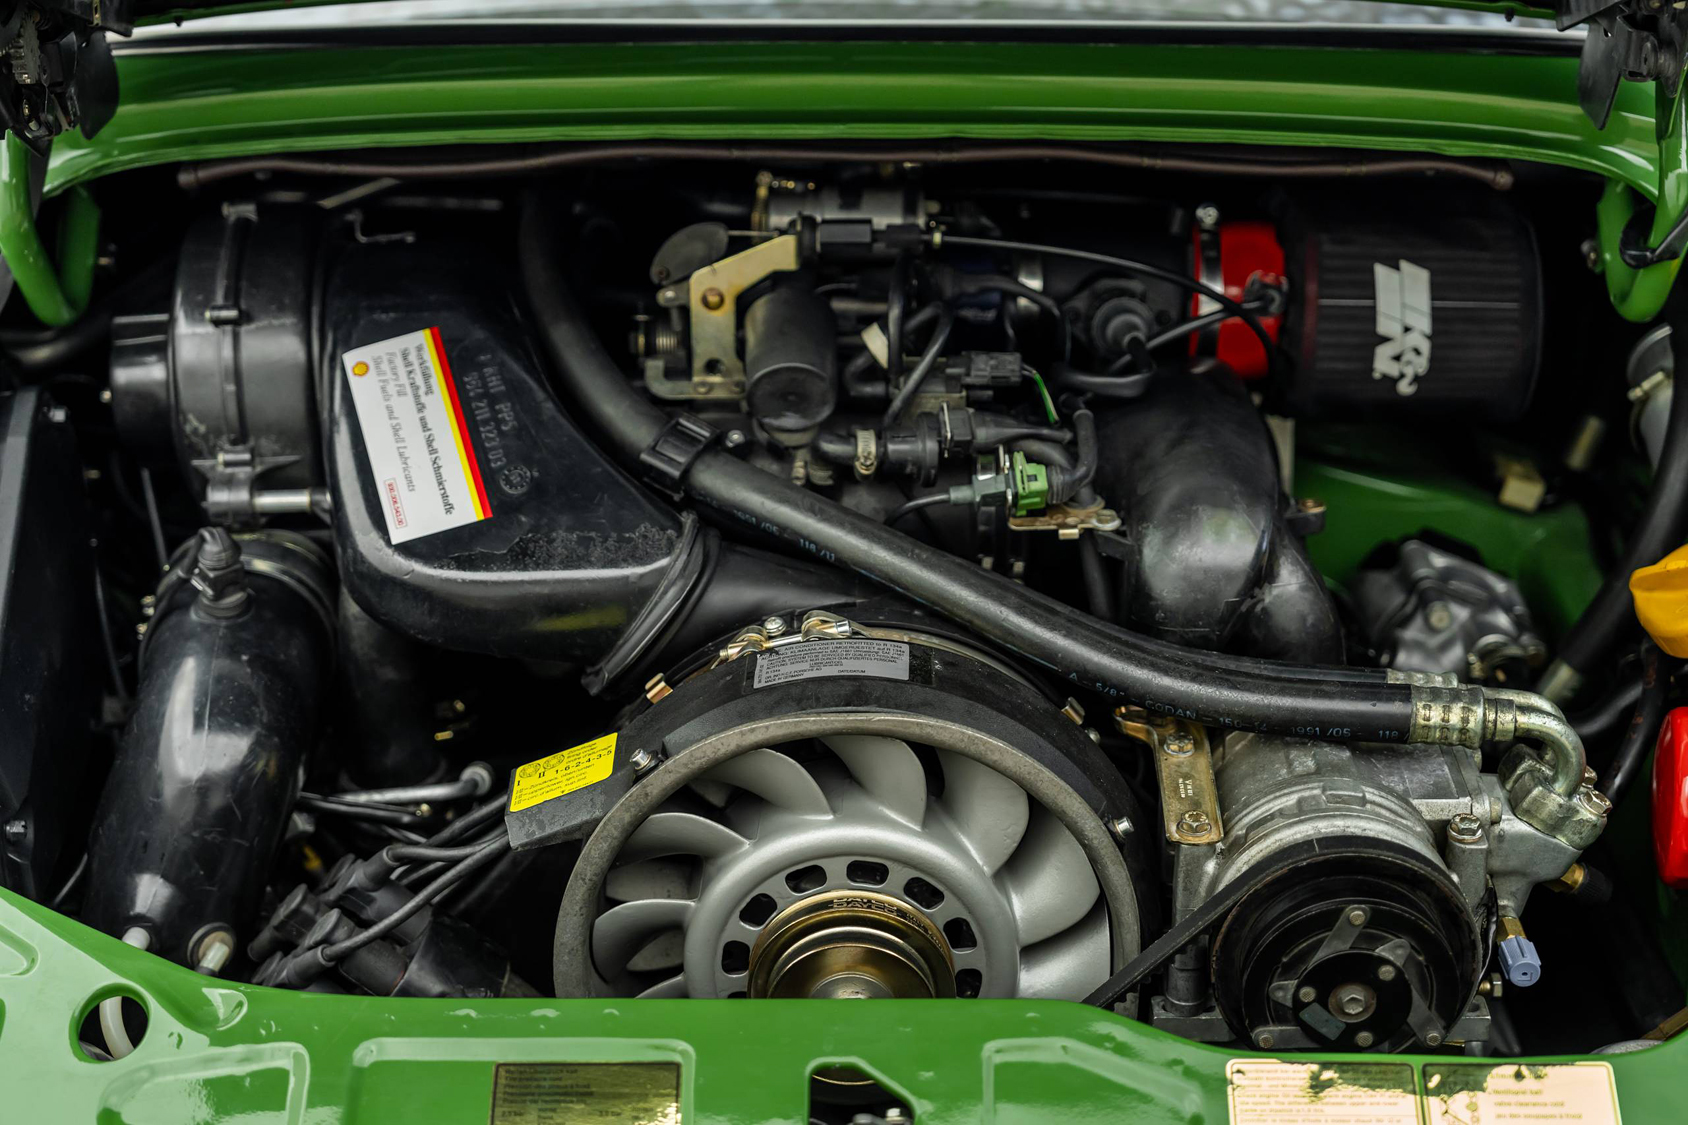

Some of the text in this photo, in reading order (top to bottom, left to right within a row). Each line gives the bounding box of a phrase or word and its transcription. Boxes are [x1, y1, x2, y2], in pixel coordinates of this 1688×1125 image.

[386, 352, 407, 397] Factory Fill
[415, 343, 434, 397] Werkfüllung
[371, 355, 416, 493] Shell Fuels and Shell Lubricants
[401, 347, 455, 515] Shell Kraftstoffe und Shell Schmierstoffe
[479, 421, 500, 448] 323
[795, 642, 835, 650] CONDITIONER
[1145, 700, 1197, 720] CODAN
[1290, 726, 1321, 736] 1991
[1377, 729, 1398, 739] 118
[833, 900, 897, 916] DAYCO
